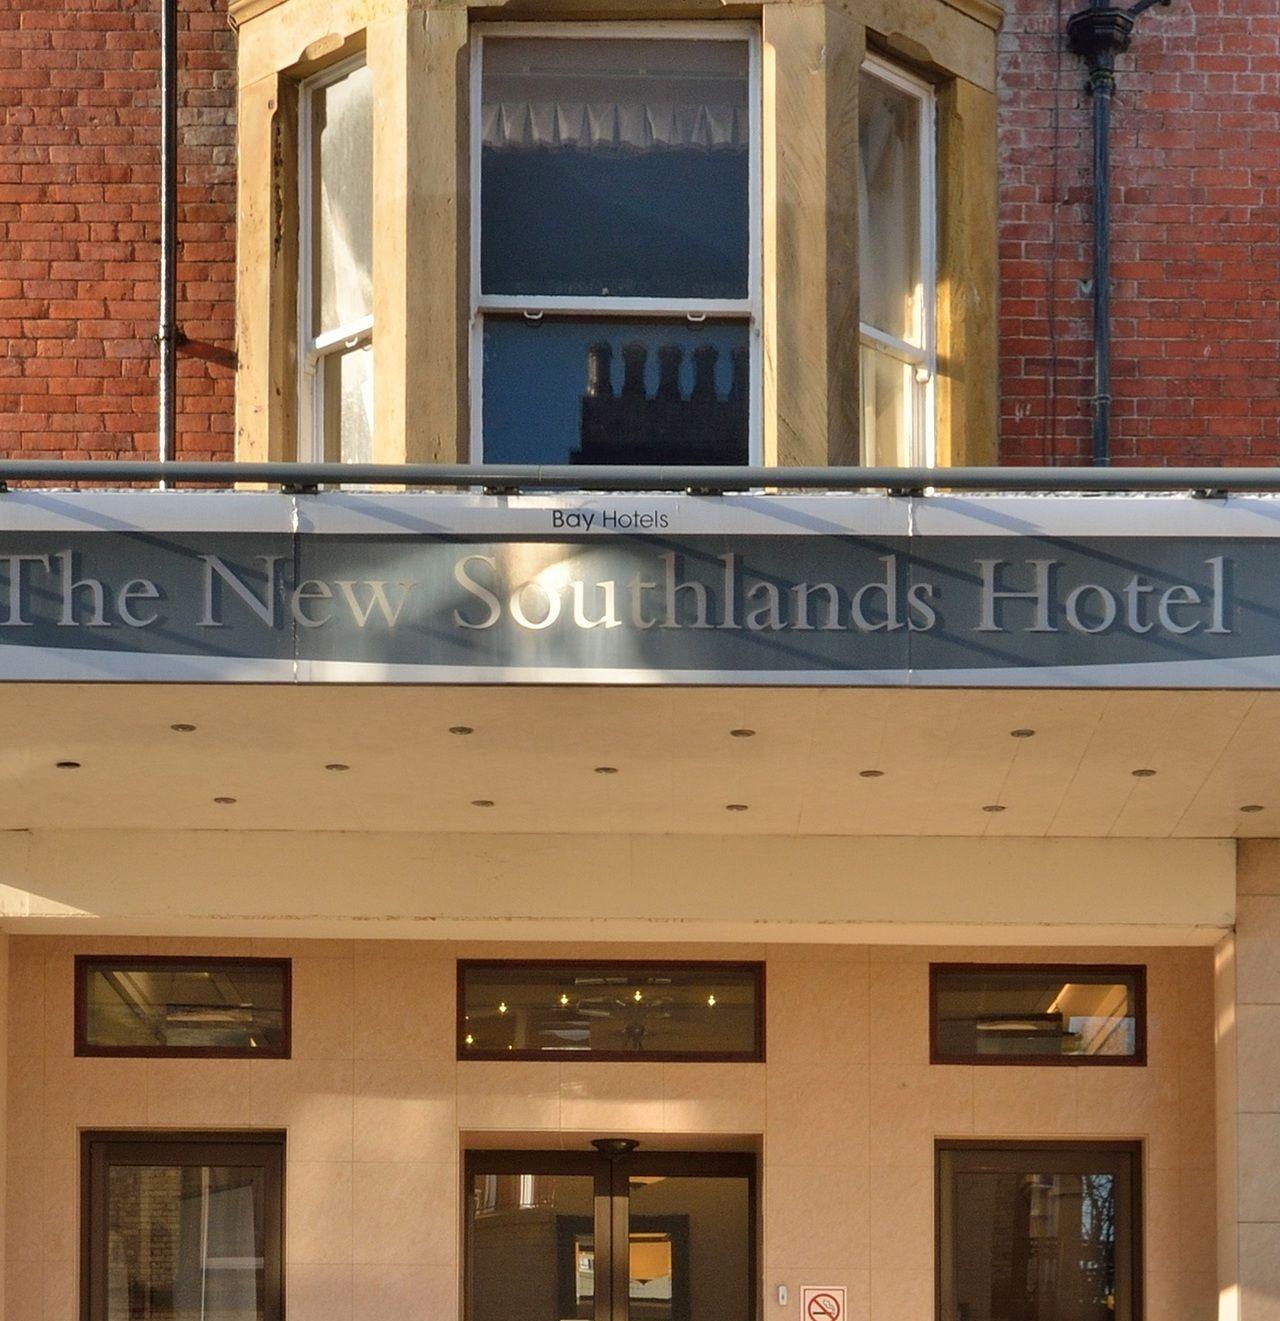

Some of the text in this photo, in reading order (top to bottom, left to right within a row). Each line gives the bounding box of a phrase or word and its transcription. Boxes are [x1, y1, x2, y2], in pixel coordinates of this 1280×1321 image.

[552, 510, 669, 531] Bay Hotels
[196, 554, 417, 630] New
[453, 551, 936, 634] Southlands
[973, 555, 1233, 635] Hotel
